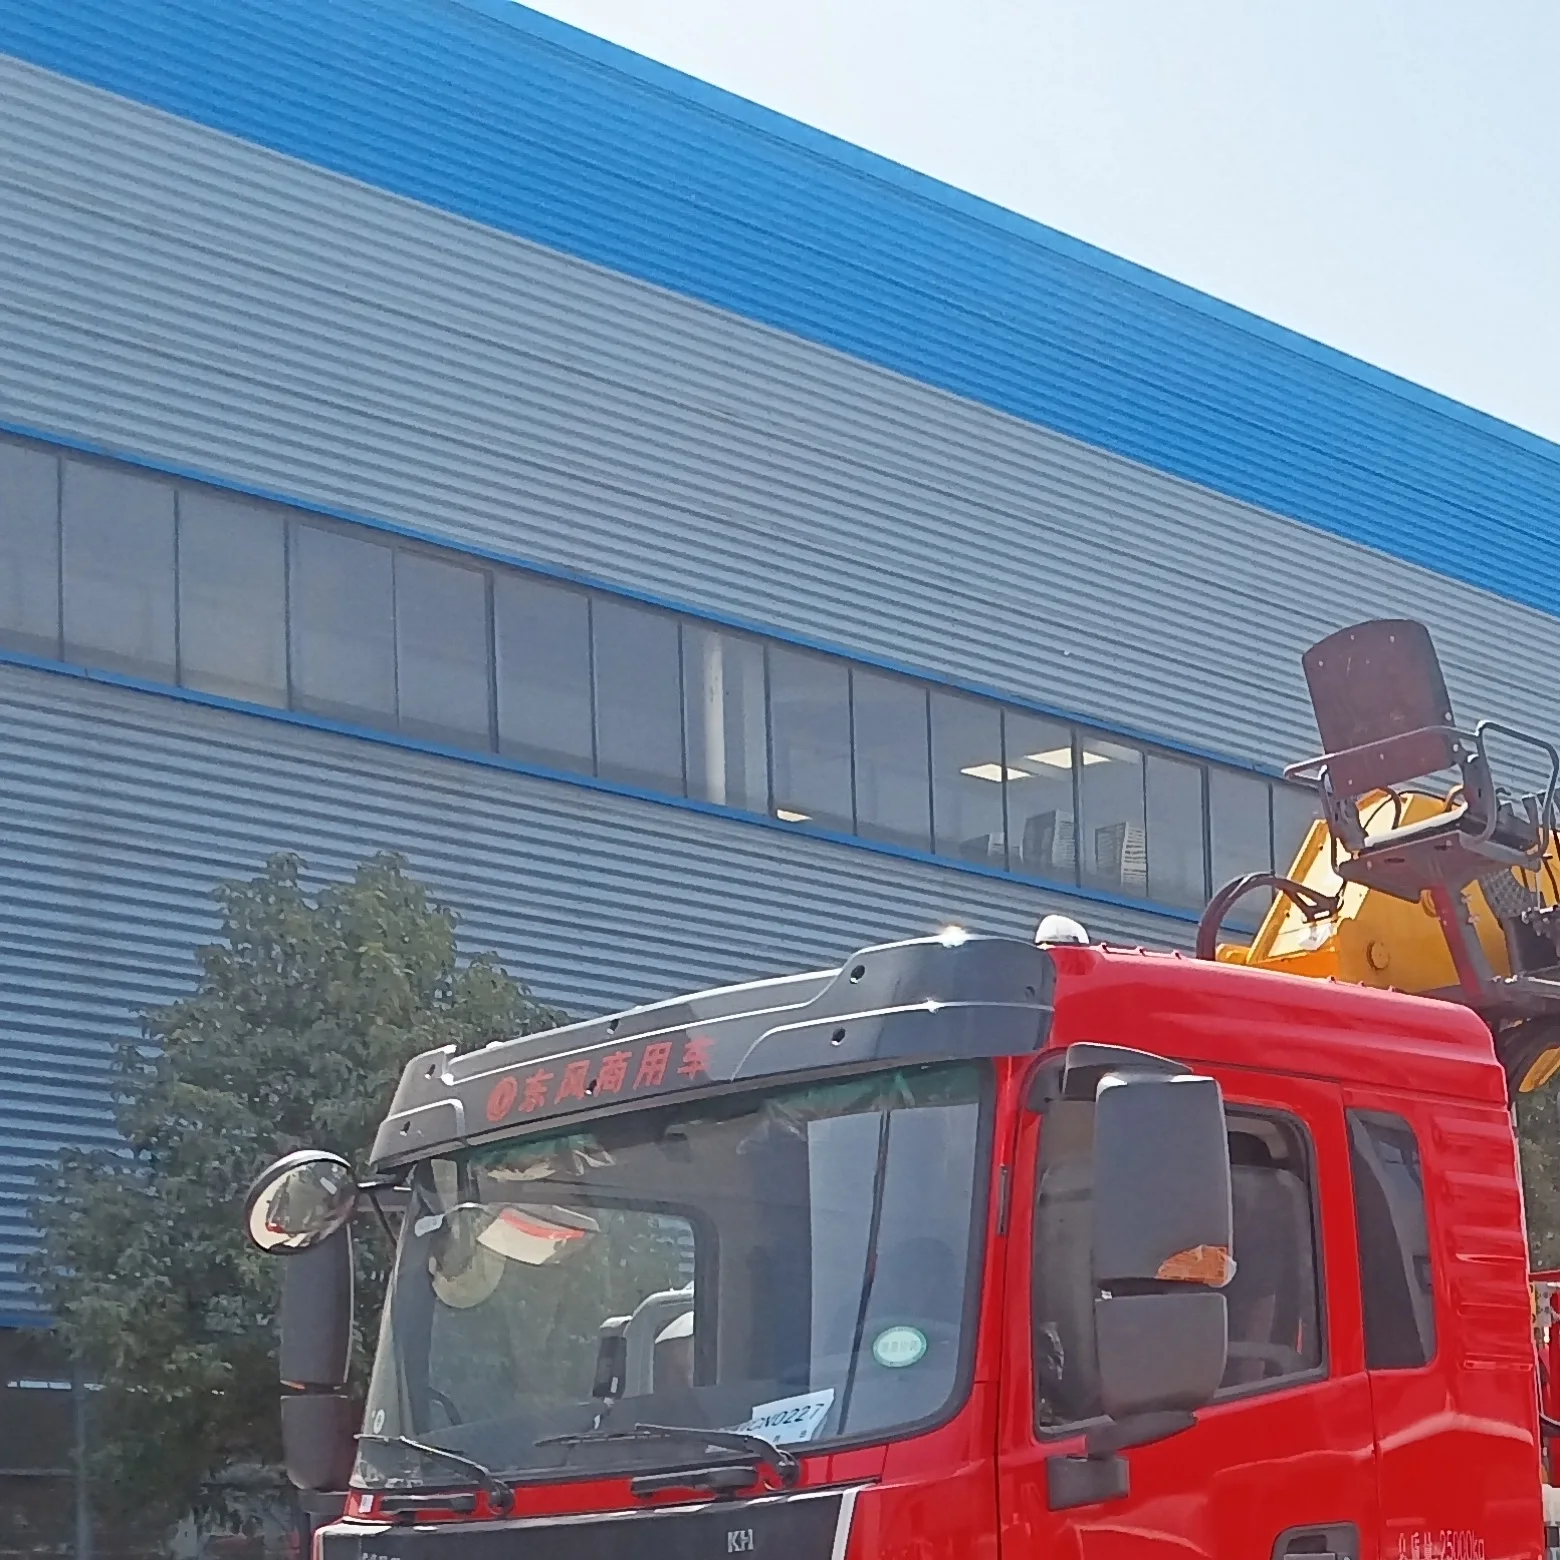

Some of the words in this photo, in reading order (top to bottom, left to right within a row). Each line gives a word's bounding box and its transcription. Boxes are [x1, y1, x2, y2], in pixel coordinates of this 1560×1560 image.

[518, 1035, 716, 1113] 东风商用车
[727, 1528, 754, 1553] KH
